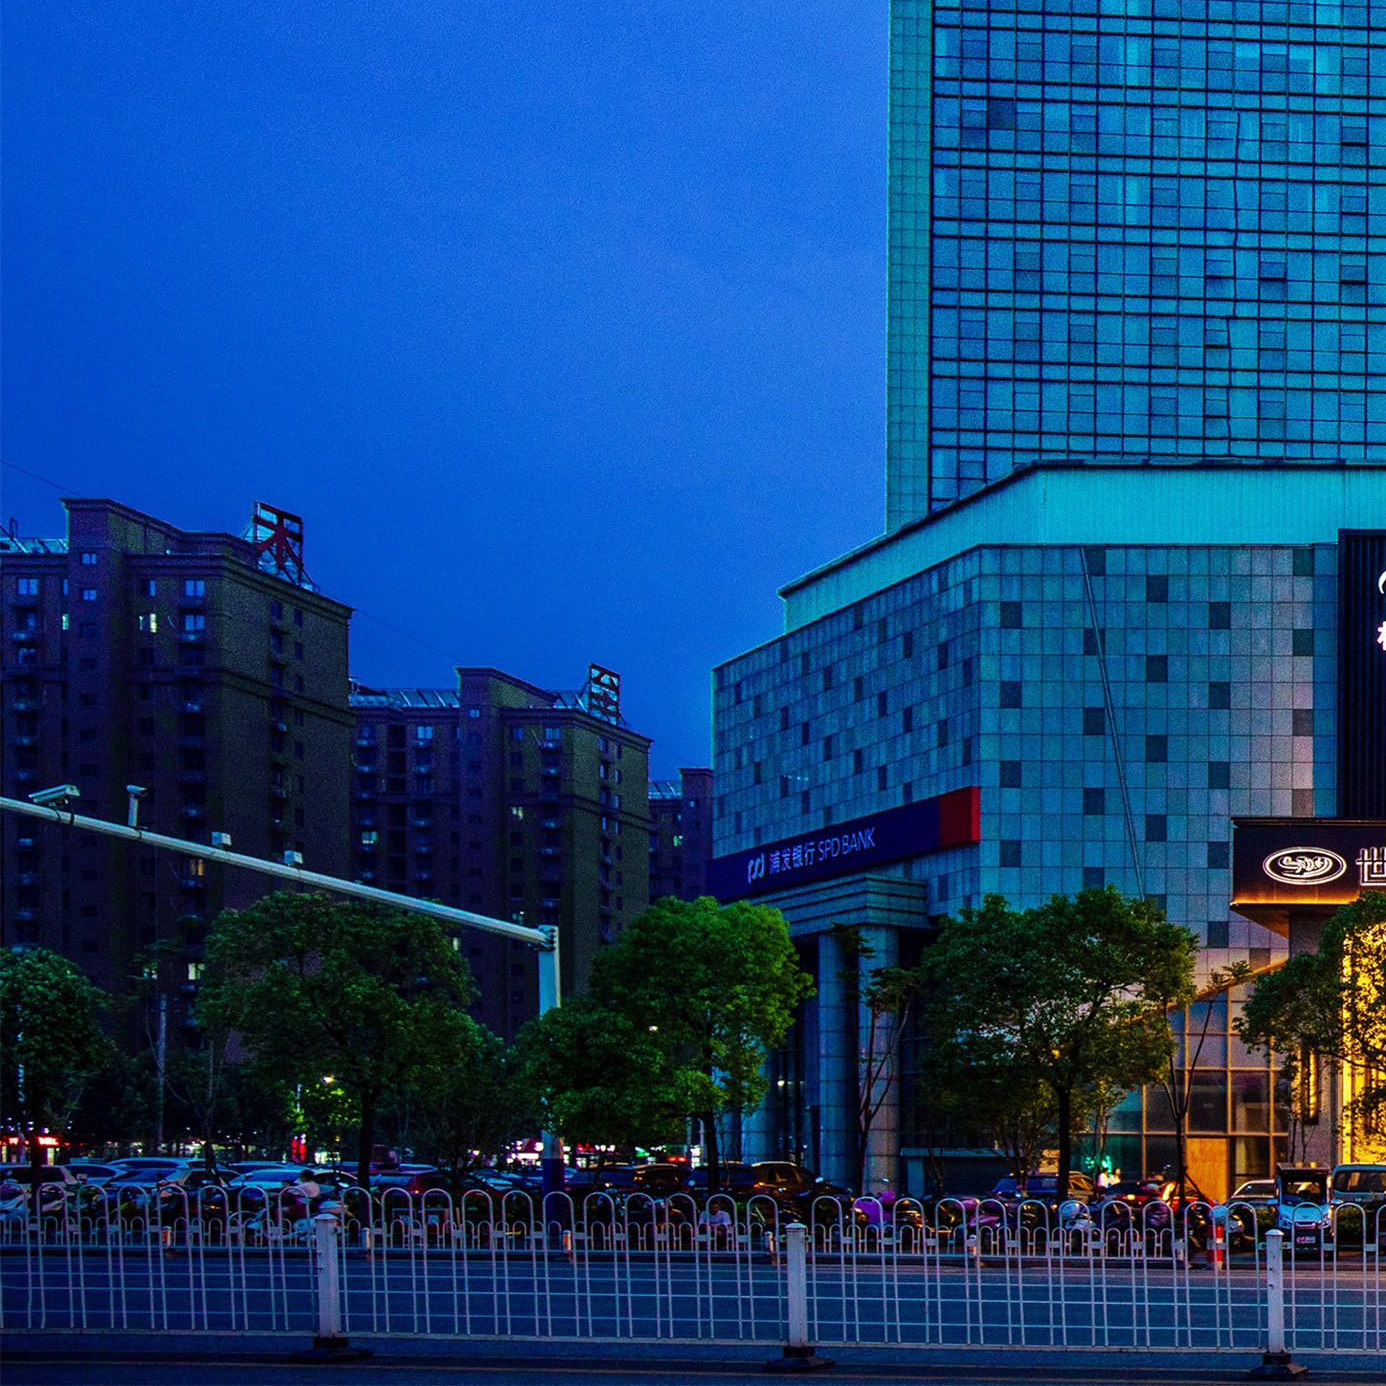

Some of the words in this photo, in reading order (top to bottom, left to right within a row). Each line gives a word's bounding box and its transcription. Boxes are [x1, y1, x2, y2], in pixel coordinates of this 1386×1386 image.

[768, 841, 816, 875] 浦发银行
[817, 837, 841, 862] SPD
[841, 826, 876, 856] BANK
